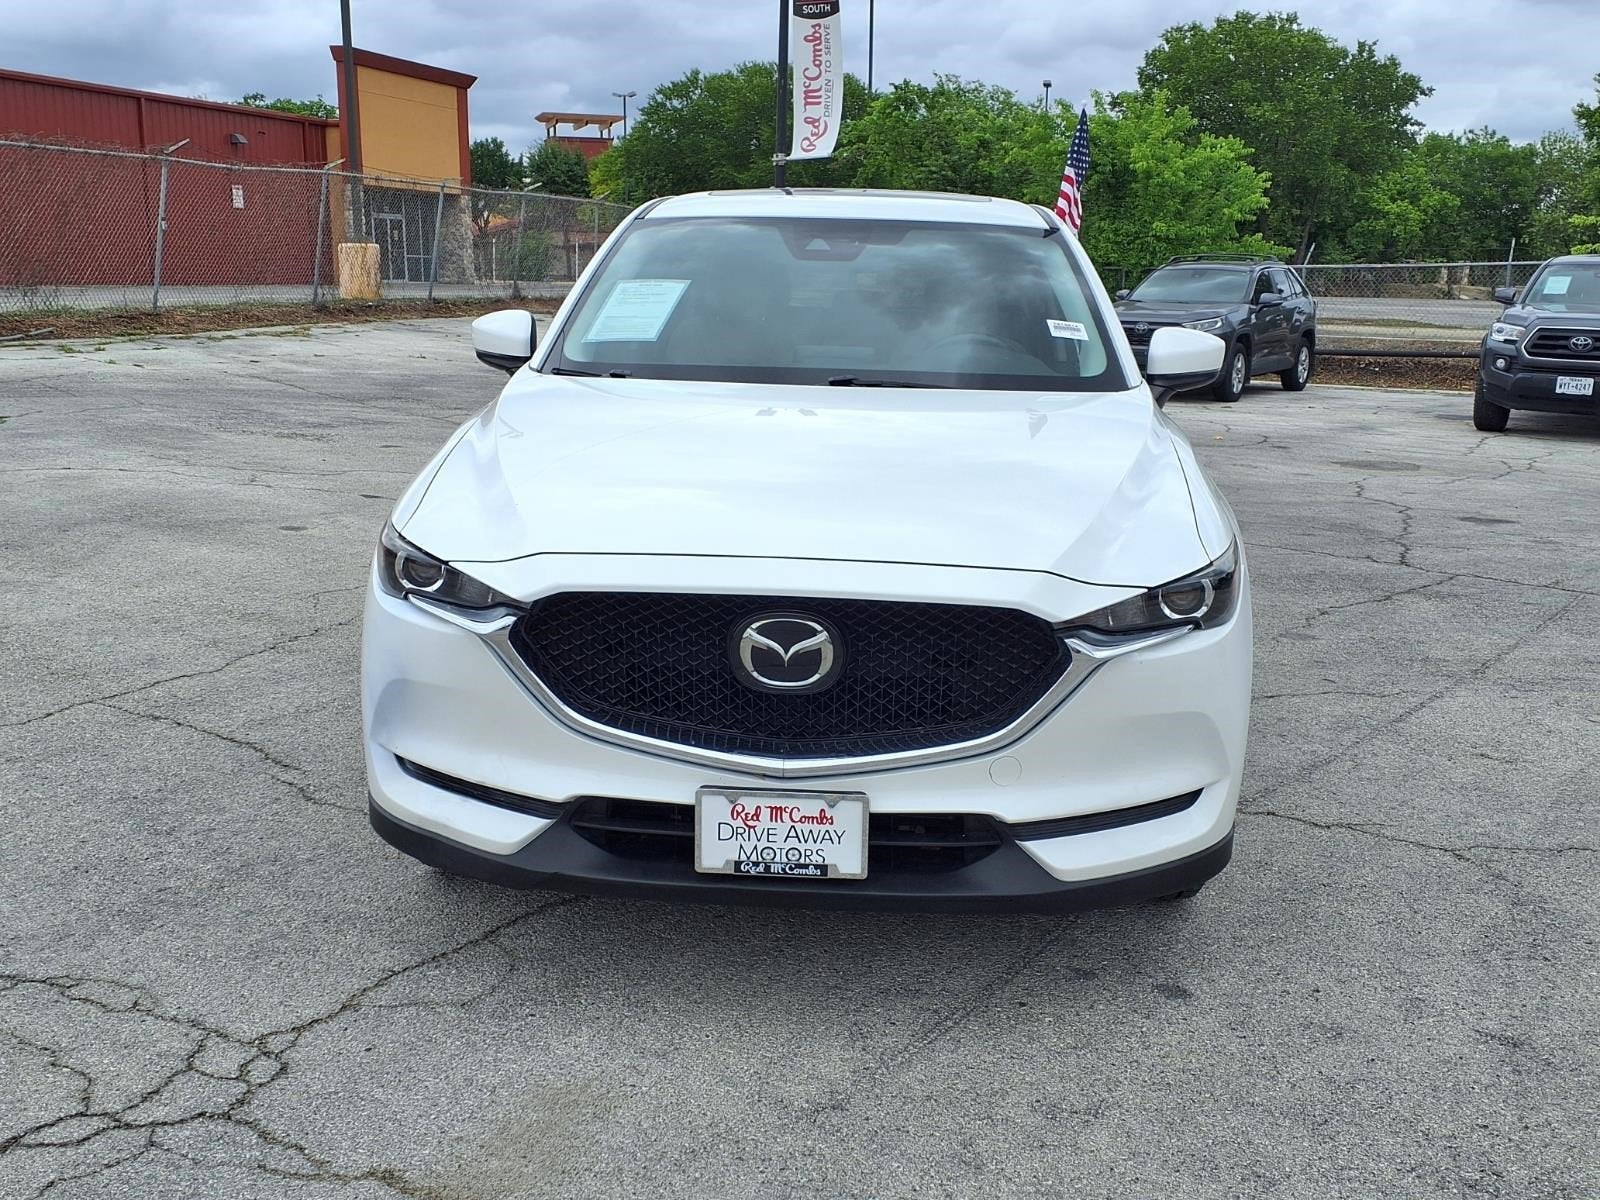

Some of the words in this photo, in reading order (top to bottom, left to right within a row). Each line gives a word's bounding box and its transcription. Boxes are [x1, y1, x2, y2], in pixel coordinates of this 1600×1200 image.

[802, 4, 831, 13] SOUTH
[824, 23, 832, 56] SERVE
[802, 22, 822, 113] McCombs
[825, 60, 831, 74] TO
[824, 78, 832, 117] DRIVEN
[800, 116, 828, 153] Red
[731, 803, 762, 829] Red
[765, 805, 834, 826] McCombs
[717, 822, 778, 843] DRIVE
[783, 825, 846, 845] AWAY
[737, 843, 826, 864] MOTORS
[740, 861, 765, 874] Red
[767, 863, 821, 876] McCombs
